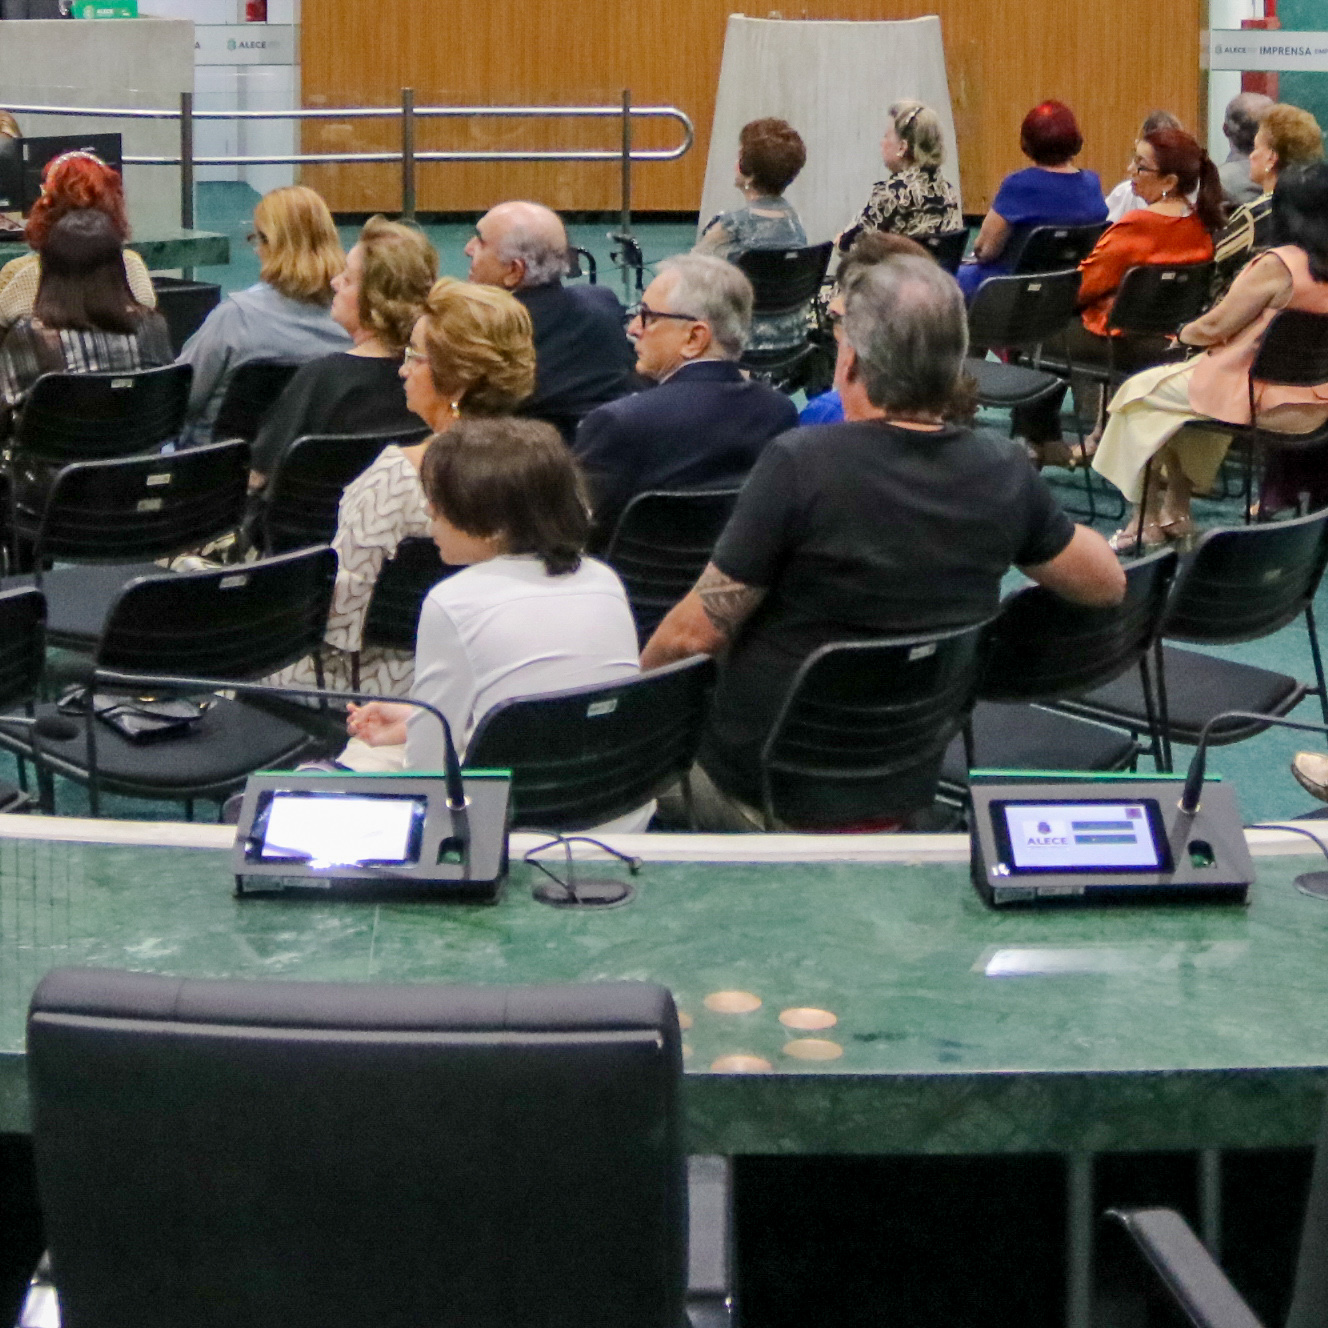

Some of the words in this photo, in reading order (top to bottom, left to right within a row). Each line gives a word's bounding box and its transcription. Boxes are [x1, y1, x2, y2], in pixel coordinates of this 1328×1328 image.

[238, 40, 267, 49] ALECE
[1259, 46, 1312, 56] IMPRENSA
[1027, 837, 1069, 846] ALECE
